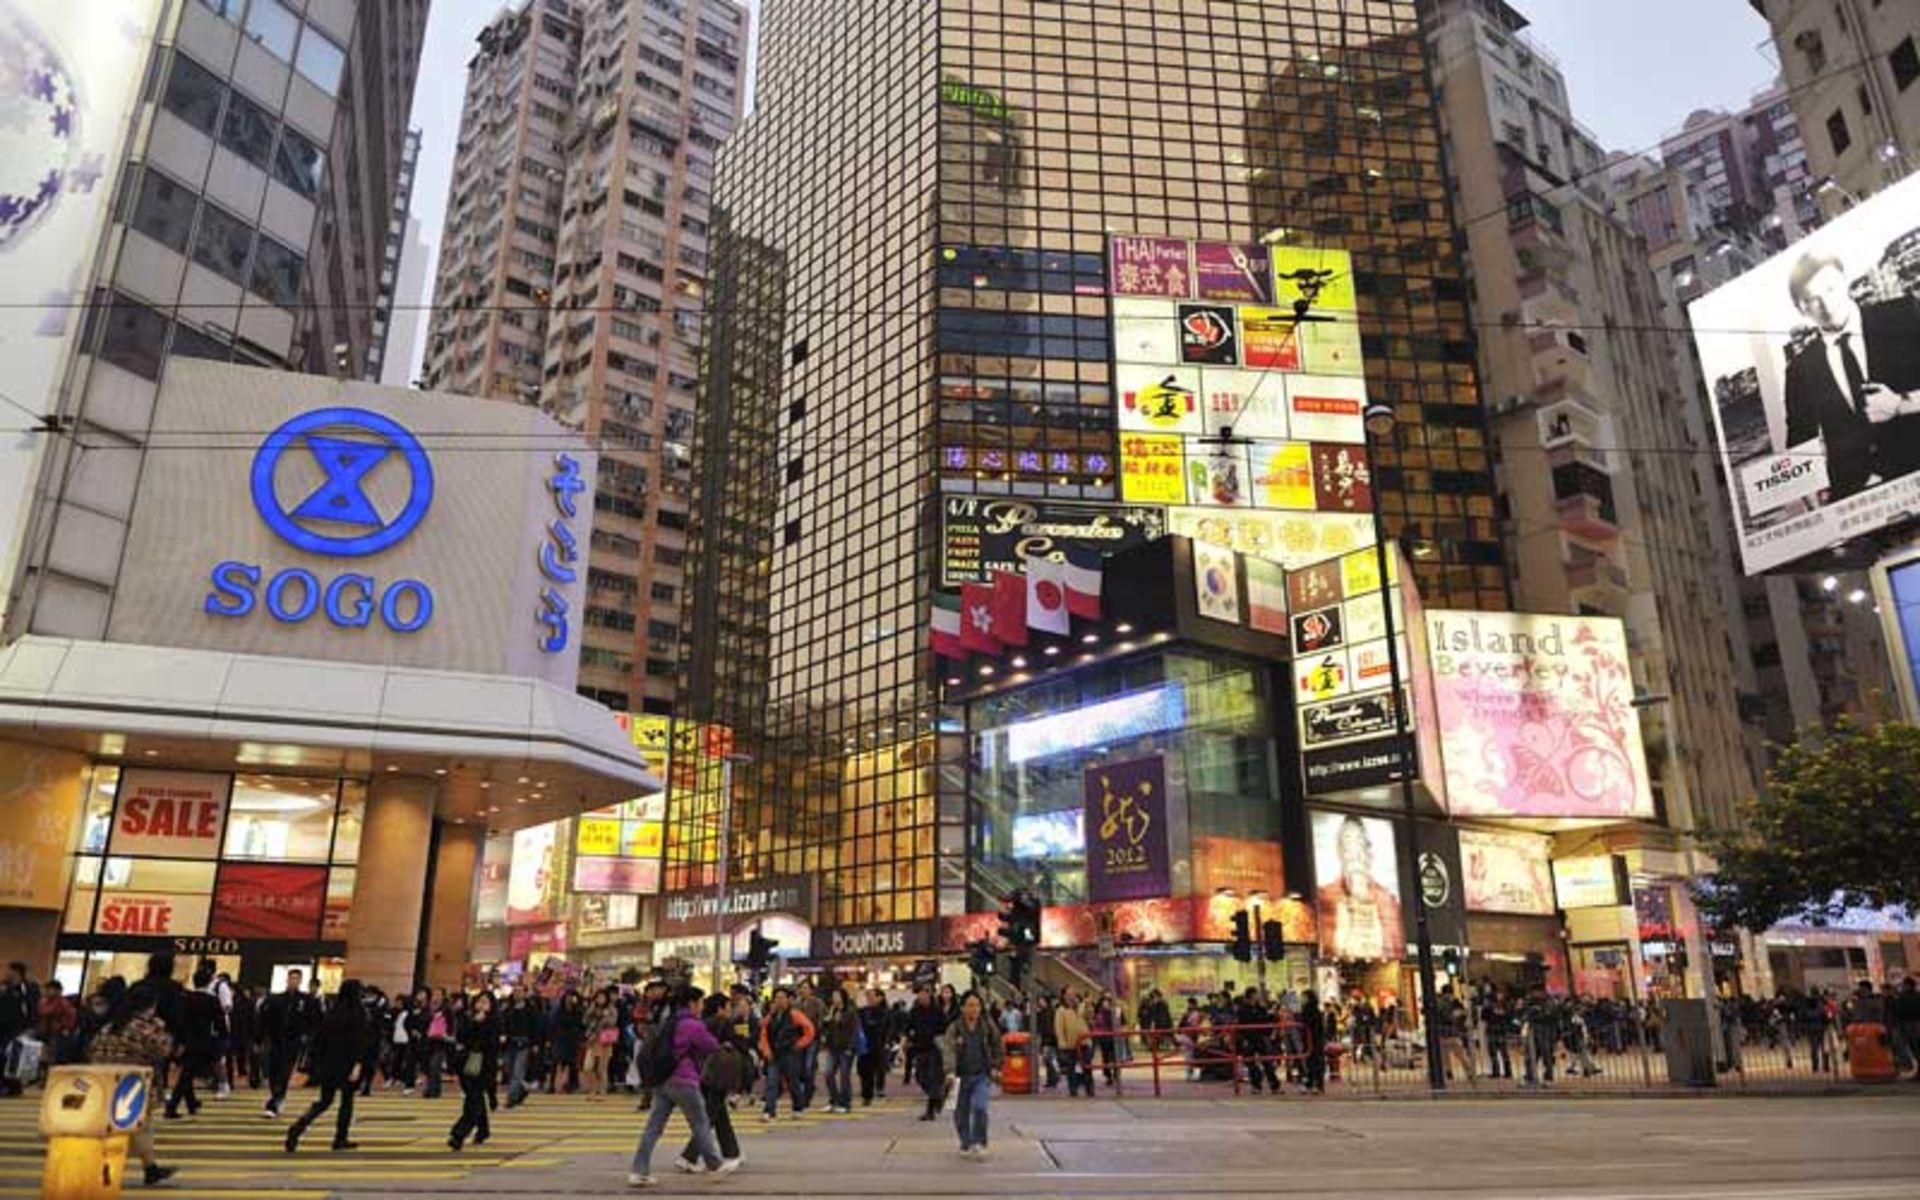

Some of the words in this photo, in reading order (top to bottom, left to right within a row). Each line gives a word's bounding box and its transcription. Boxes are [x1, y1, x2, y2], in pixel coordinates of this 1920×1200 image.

[1115, 238, 1156, 263] THAI
[1754, 460, 1813, 492] TISSOT
[204, 560, 434, 633] SOGO
[1434, 618, 1566, 656] Island
[120, 797, 220, 838] SALE
[1105, 846, 1147, 865] 2012
[101, 904, 172, 934] SALE
[174, 938, 239, 952] SOGO
[832, 930, 905, 954] bauhaus
